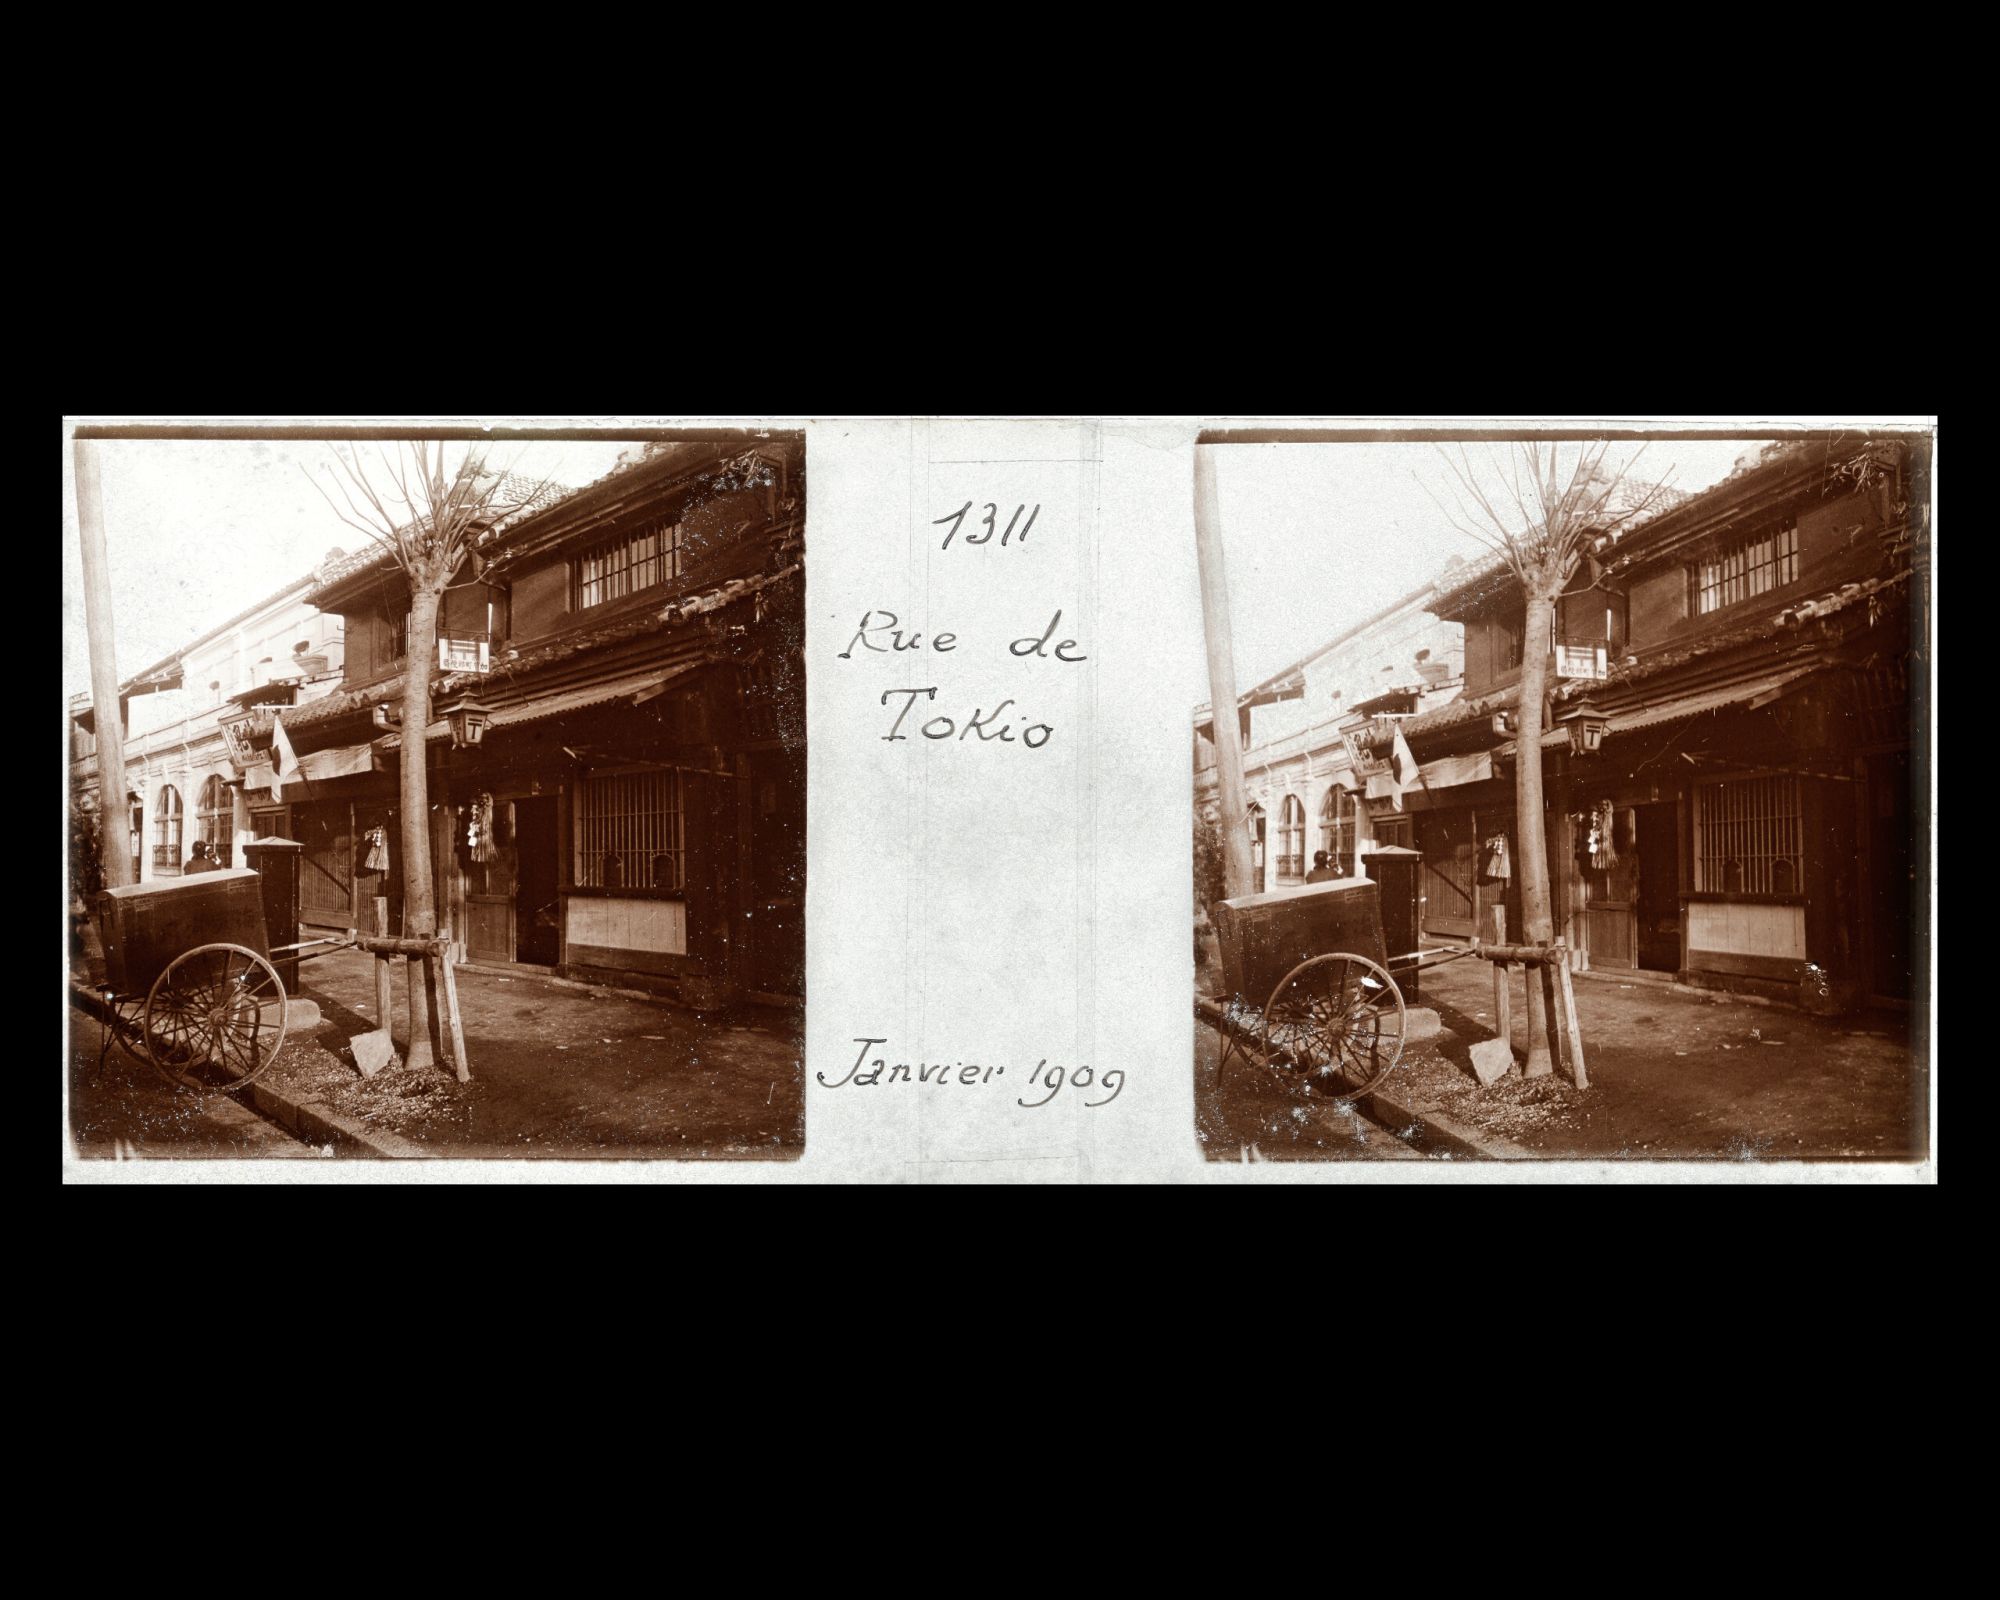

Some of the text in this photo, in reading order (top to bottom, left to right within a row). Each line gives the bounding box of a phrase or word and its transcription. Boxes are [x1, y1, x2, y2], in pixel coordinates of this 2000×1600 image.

[932, 501, 1041, 550] 1311
[837, 609, 1088, 662] Rue de
[816, 1038, 1126, 1108] Janvier 1909
